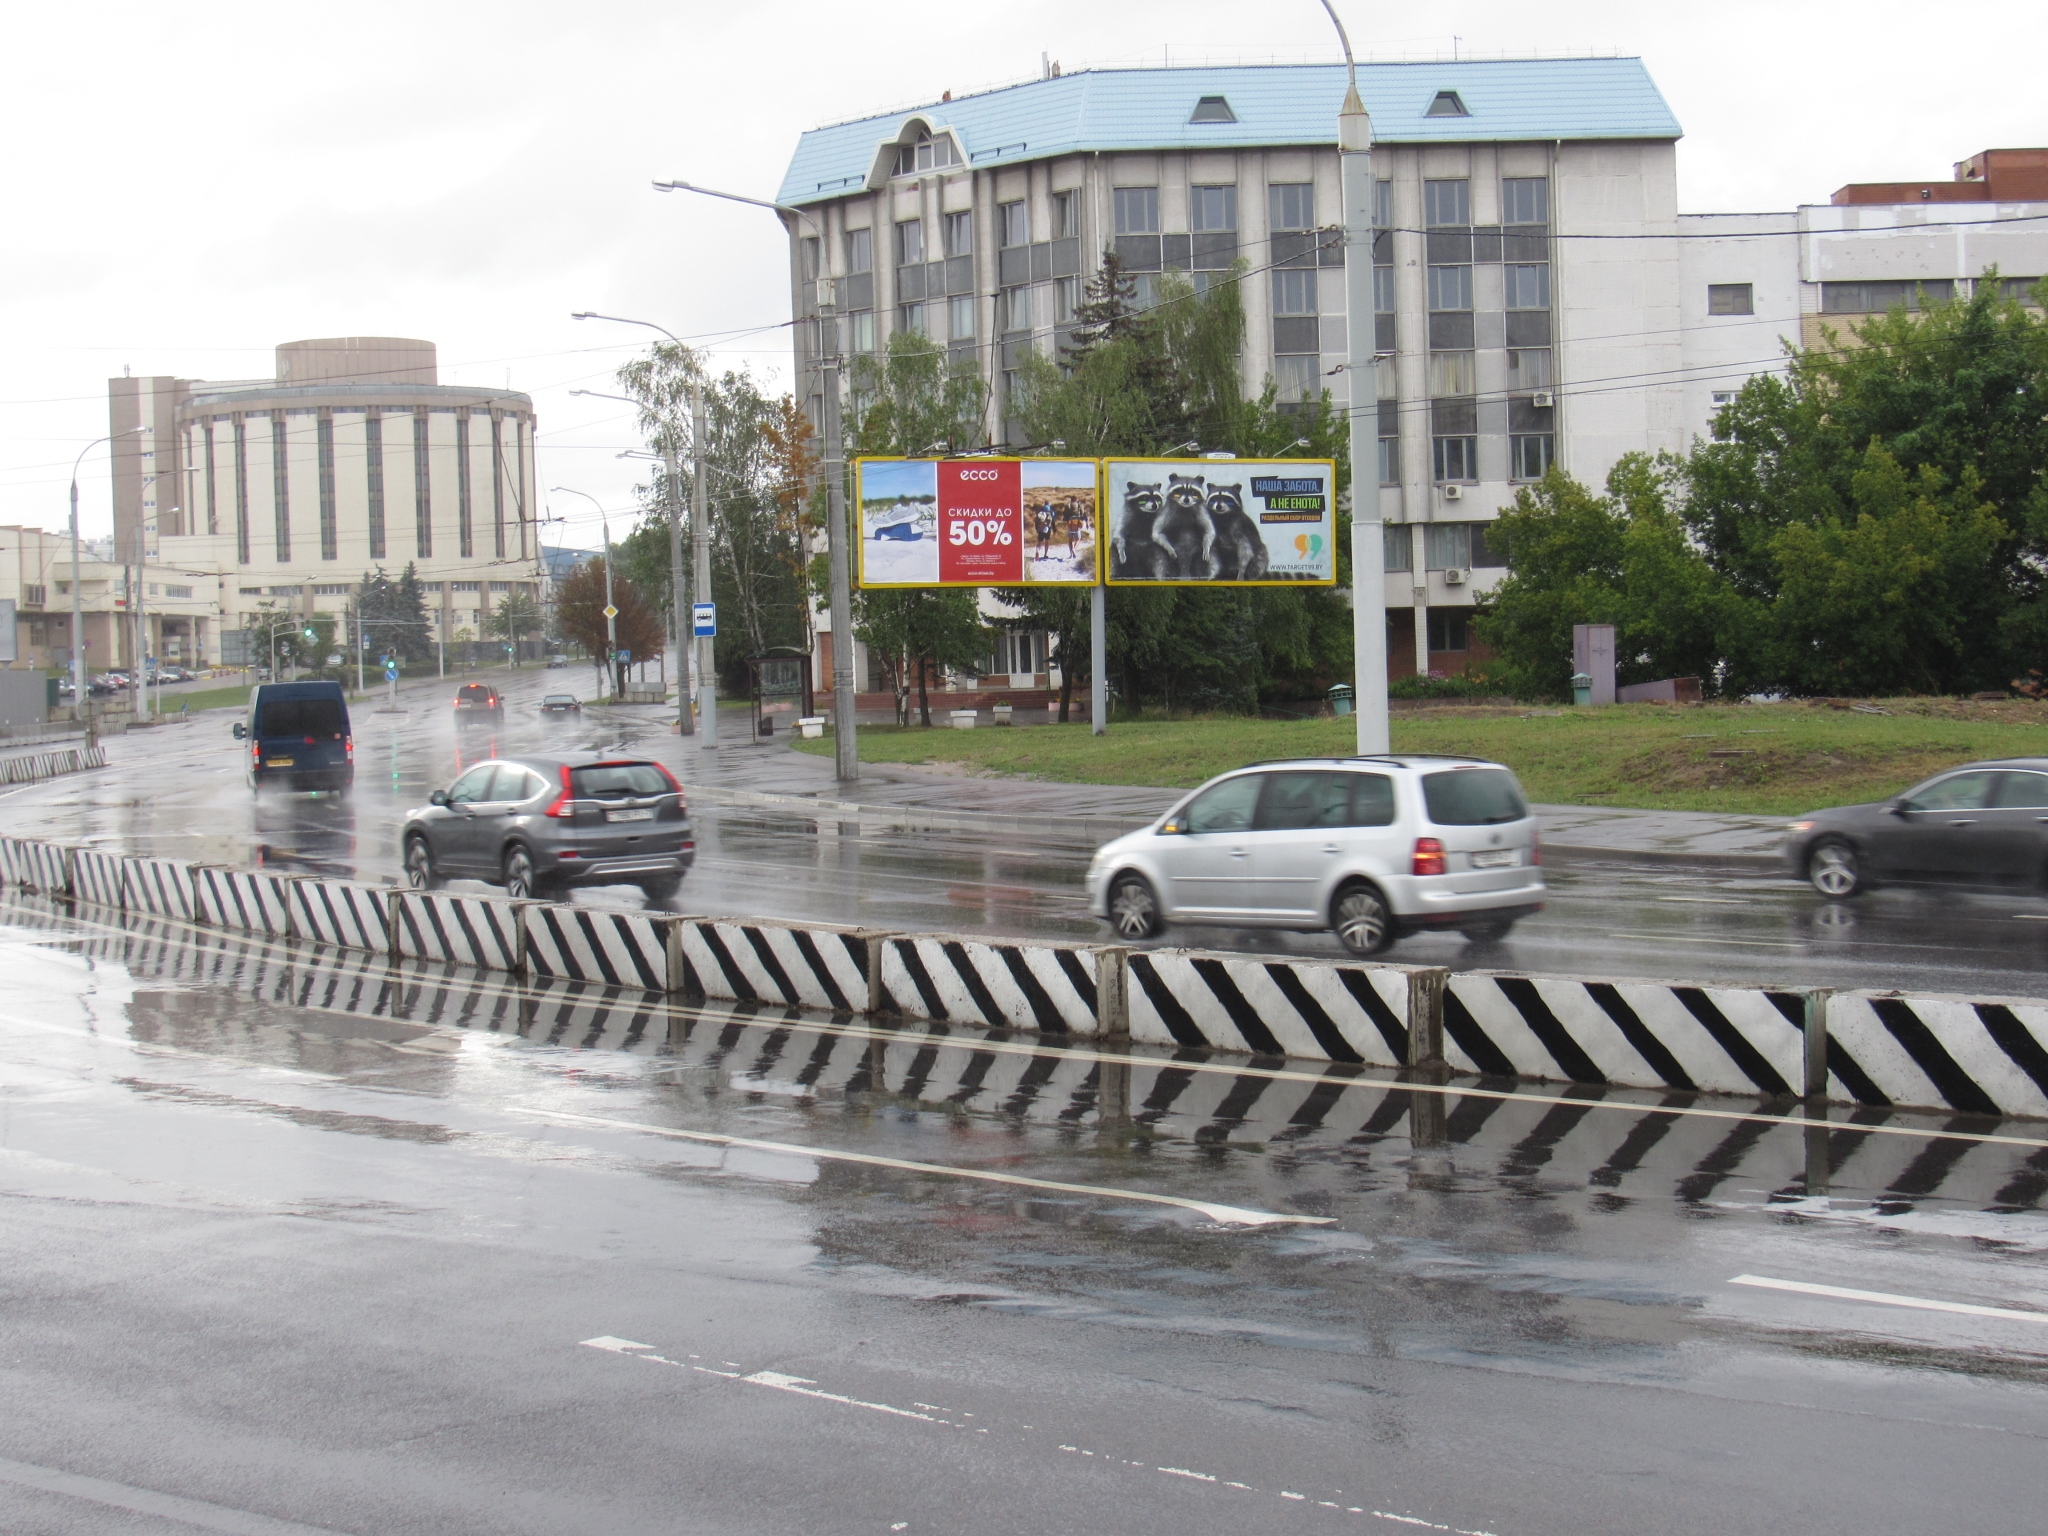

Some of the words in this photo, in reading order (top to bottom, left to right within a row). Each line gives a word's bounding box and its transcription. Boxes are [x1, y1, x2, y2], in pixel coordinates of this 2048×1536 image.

[960, 470, 998, 481] ecco
[1256, 480, 1282, 492] НАША
[1284, 480, 1320, 493] ЗАБОТА,
[1270, 498, 1277, 509] А
[1278, 498, 1289, 509] НЕ
[1291, 498, 1320, 509] ЕНОТА!
[948, 508, 992, 517] СКИДКИ
[996, 508, 1012, 517] ДО
[949, 520, 1013, 546] 50%
